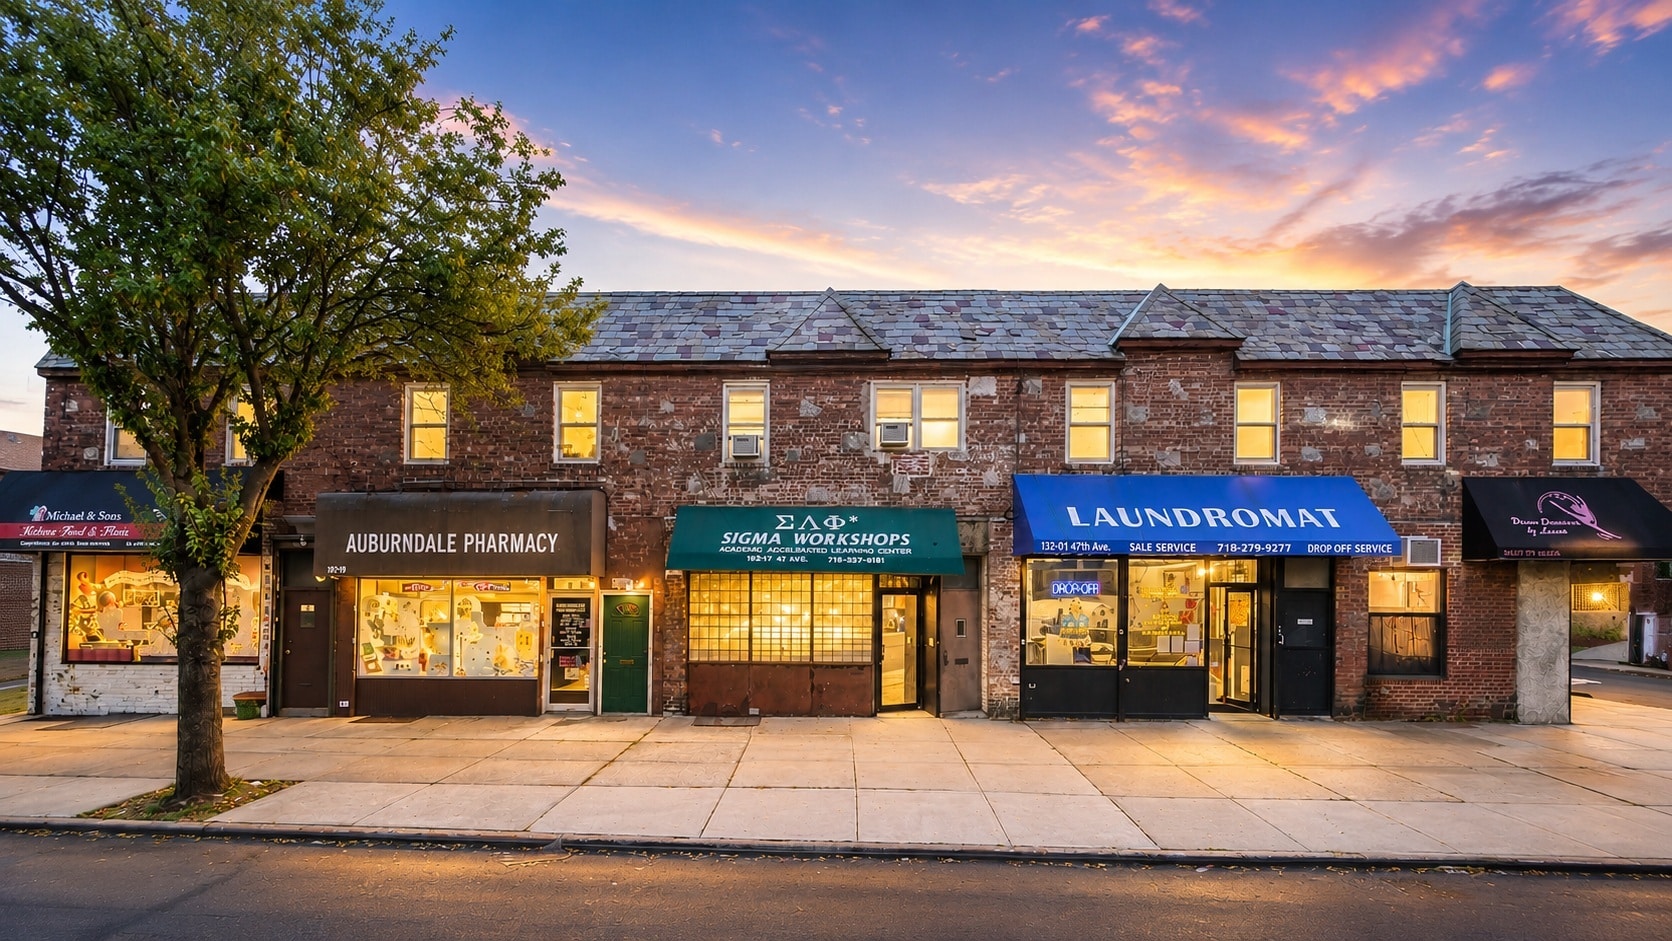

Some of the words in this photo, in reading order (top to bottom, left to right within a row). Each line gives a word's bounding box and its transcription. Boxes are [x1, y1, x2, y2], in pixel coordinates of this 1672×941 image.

[46, 509, 85, 521] Michael
[86, 510, 97, 521] &
[97, 510, 122, 521] Sons
[1066, 506, 1341, 528] LAUNDROMAT
[345, 533, 457, 553] AUBURNDALE
[464, 532, 559, 553] PHARMACY
[720, 531, 782, 545] SIGMA
[794, 532, 911, 546] WORKSHOPS
[1070, 541, 1091, 552] 47th
[1091, 541, 1111, 552] Ave.
[1129, 542, 1153, 552] SALE
[1155, 542, 1197, 553] SERVICE
[1217, 543, 1292, 553] 718-279-9277
[1307, 543, 1333, 554] DROP
[1333, 543, 1352, 553] OFF
[1354, 543, 1393, 554] SERVICE
[789, 555, 809, 563] AVE.
